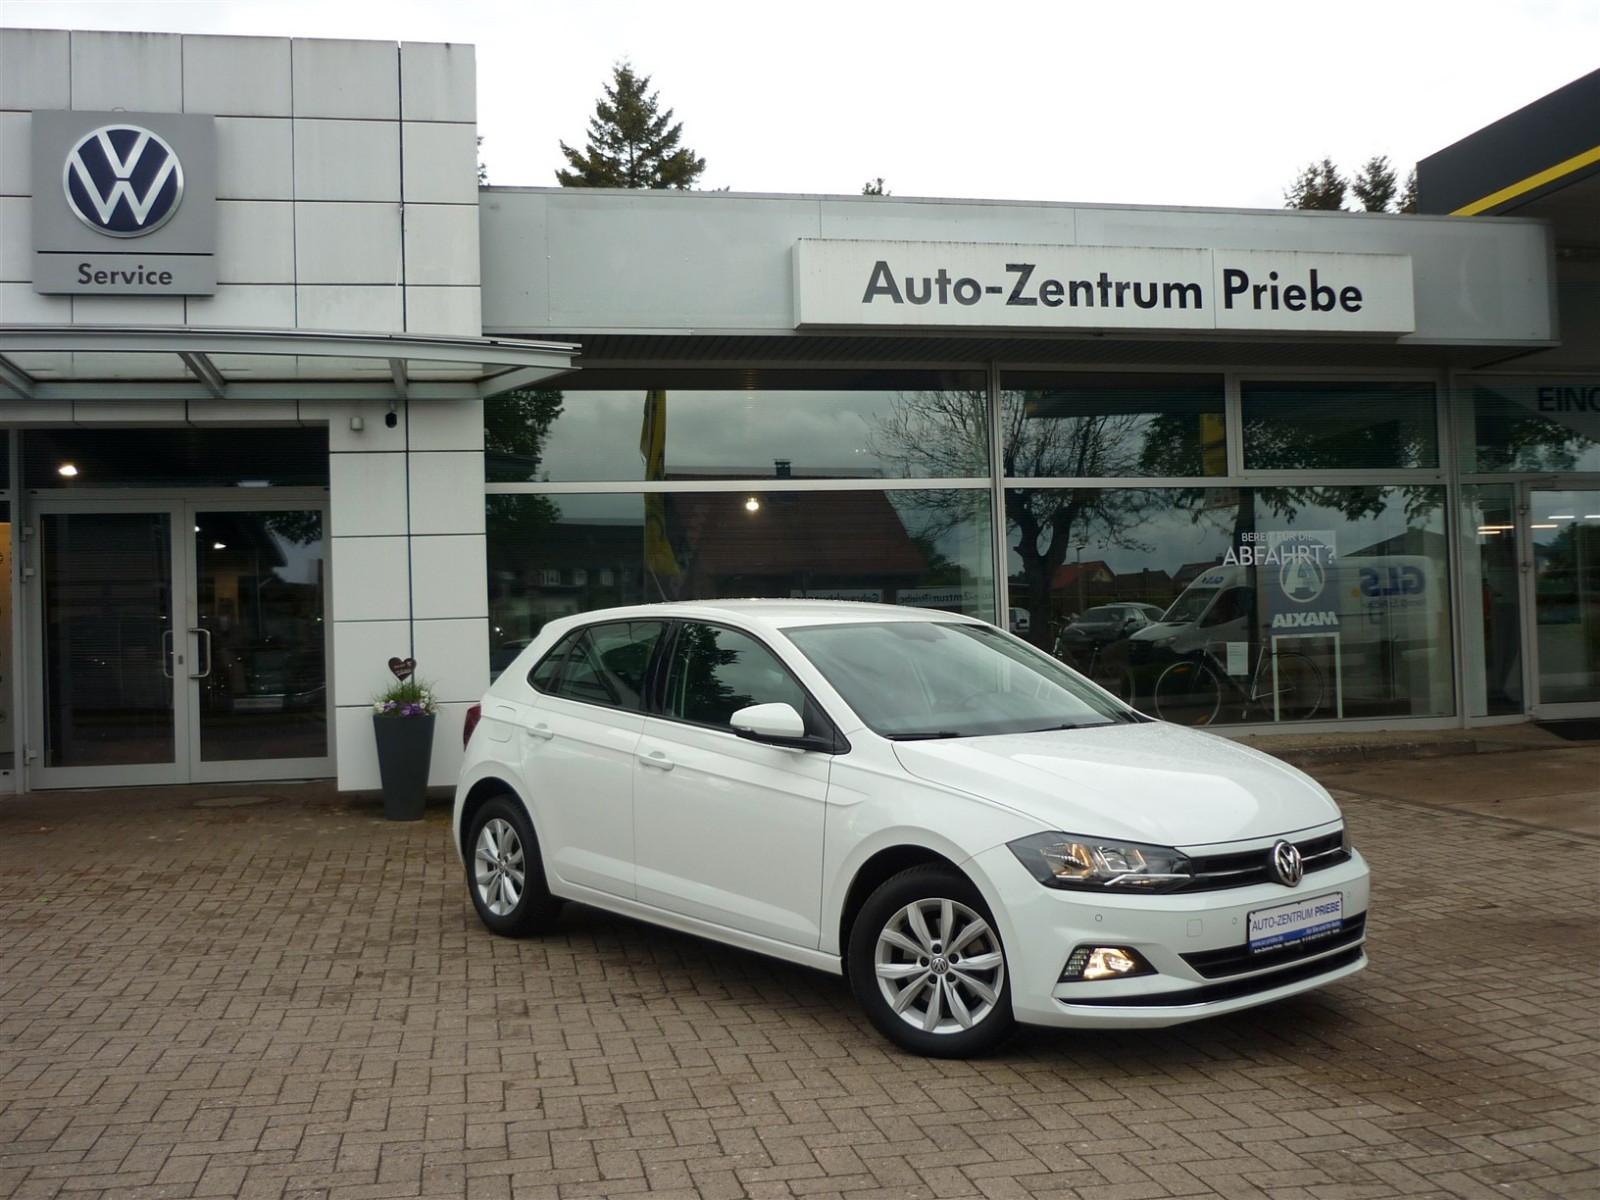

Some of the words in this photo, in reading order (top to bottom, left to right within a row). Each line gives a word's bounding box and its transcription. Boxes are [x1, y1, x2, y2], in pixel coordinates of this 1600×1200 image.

[77, 263, 173, 285] Service
[862, 260, 1203, 309] Auto-Zentrum
[1223, 268, 1363, 312] Priebe
[1222, 545, 1336, 567] ABFAHRT?
[1271, 611, 1339, 629] AIXAM
[1252, 908, 1314, 932] AUTO-ZENTRUM
[1314, 900, 1341, 917] PRIEBE
